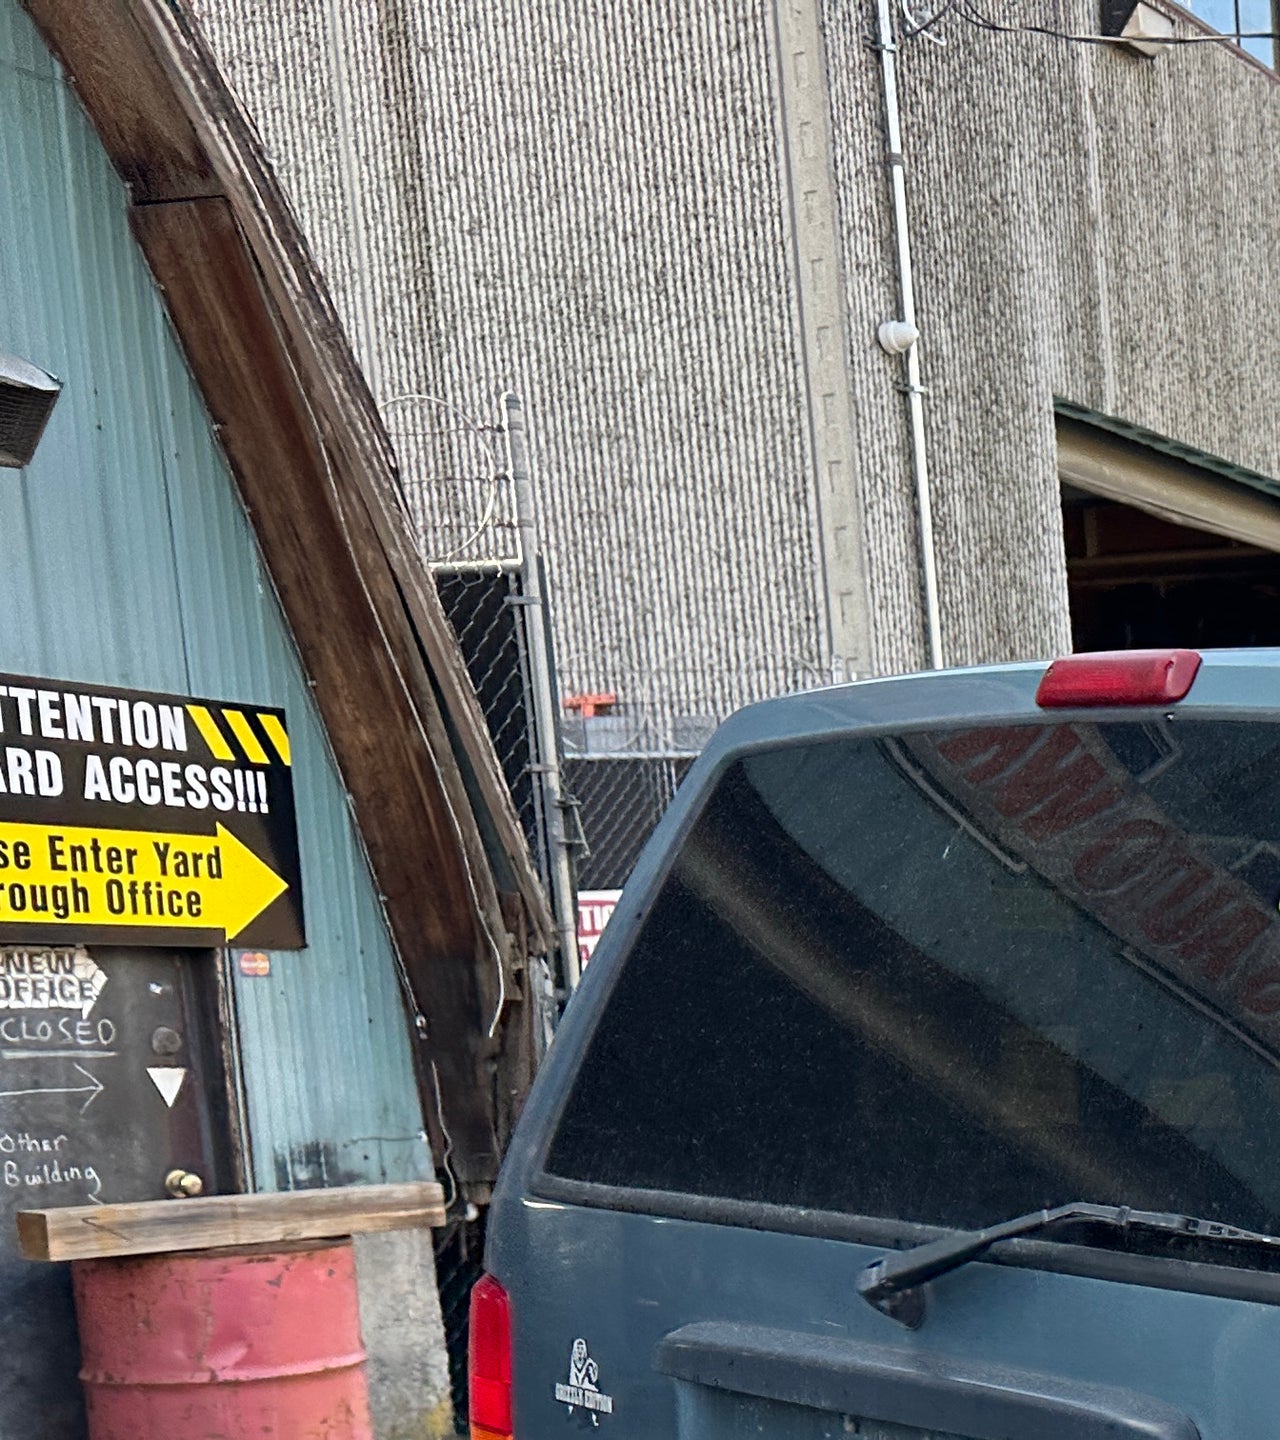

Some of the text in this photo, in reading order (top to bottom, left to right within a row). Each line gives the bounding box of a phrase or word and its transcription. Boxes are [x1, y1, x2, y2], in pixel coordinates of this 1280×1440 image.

[84, 754, 269, 814] ACCESS!!!
[48, 835, 138, 874] Enter
[153, 841, 222, 879] Yard
[105, 878, 202, 917] Office
[7, 952, 75, 974] NEW
[1, 1017, 116, 1045] CLOSED
[4, 1160, 102, 1195] Building
